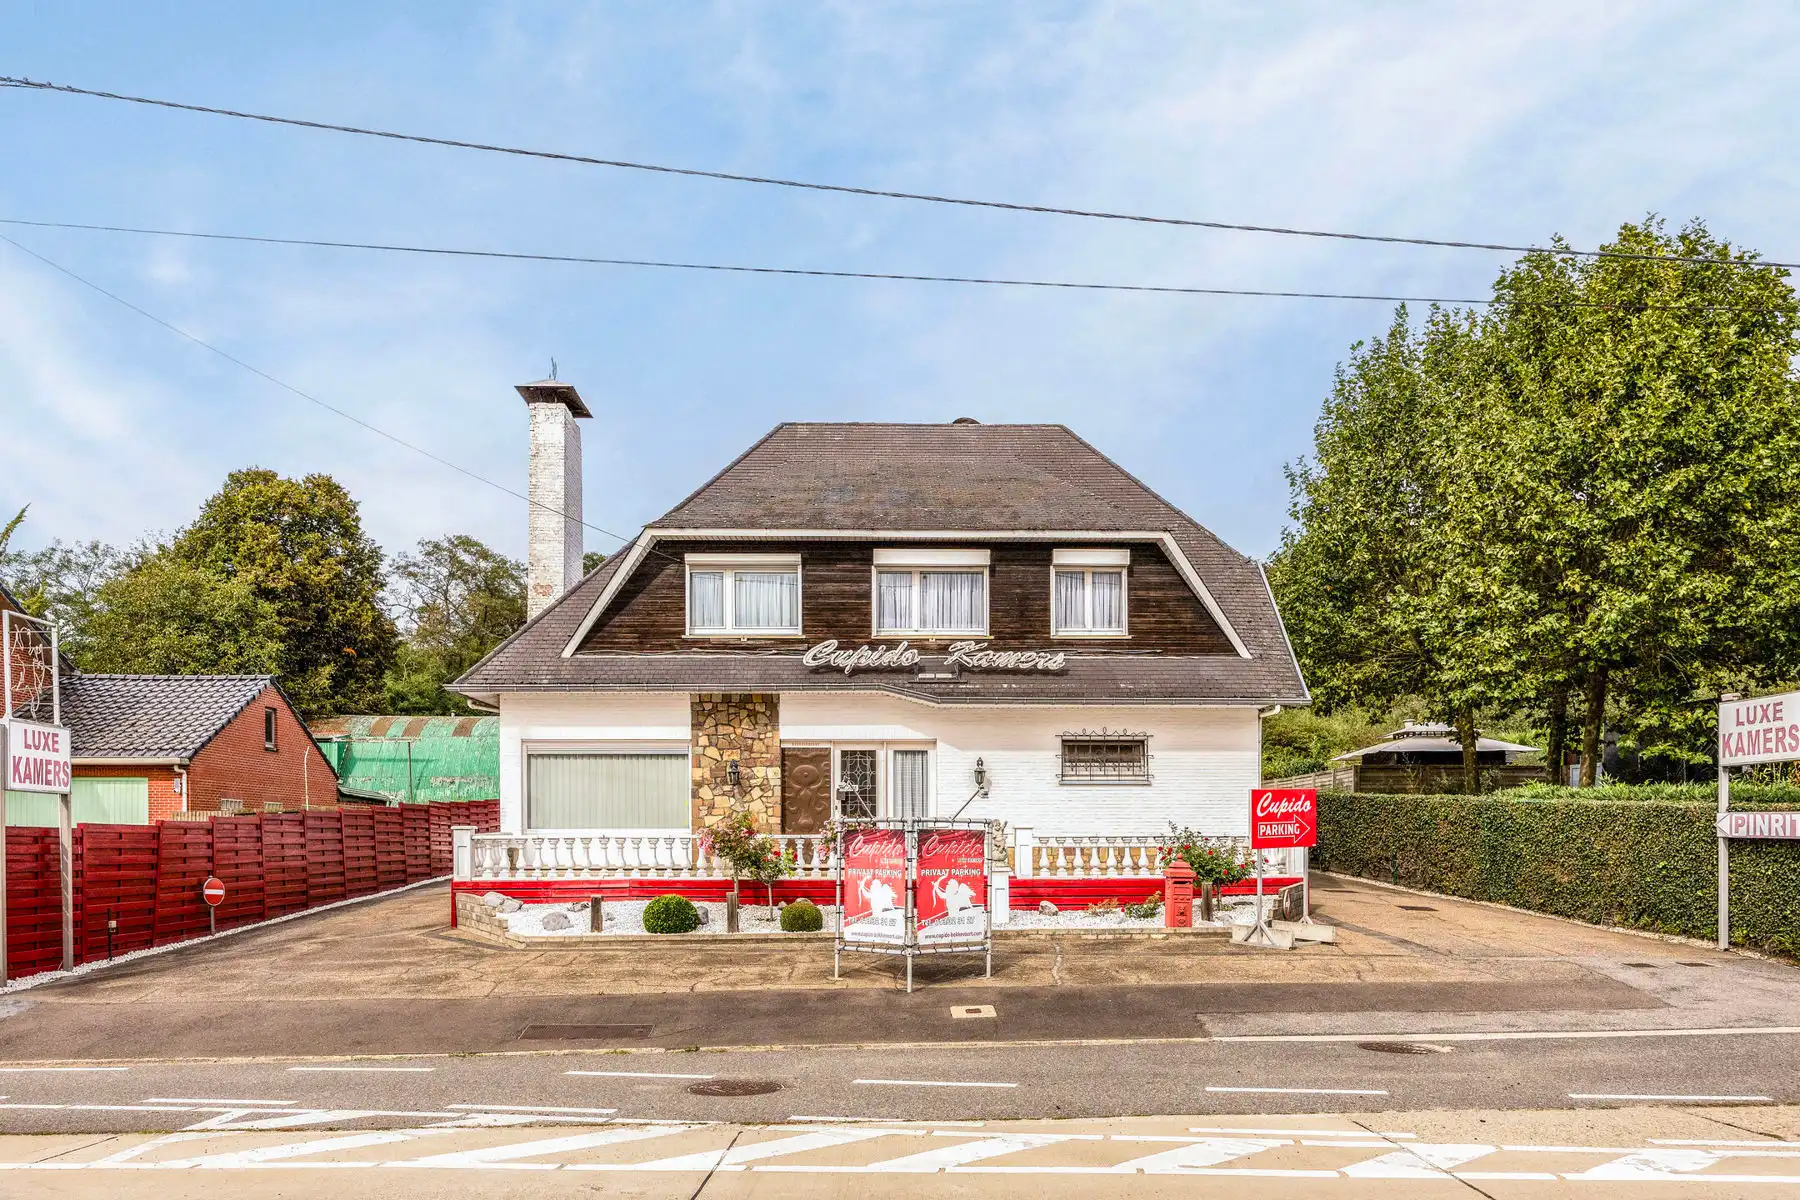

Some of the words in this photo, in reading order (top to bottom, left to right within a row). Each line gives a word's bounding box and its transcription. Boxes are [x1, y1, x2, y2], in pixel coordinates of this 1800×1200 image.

[803, 639, 920, 675] Cupido
[944, 640, 1066, 671] Kamers
[1736, 701, 1784, 727] LUXE
[24, 728, 60, 753] LUXE
[1721, 724, 1800, 758] KAMERS
[12, 755, 70, 788] KAMERS
[1257, 792, 1312, 818] Cupido
[1259, 824, 1300, 836] PARKING
[849, 835, 903, 862] Cupido
[922, 835, 982, 862] Cupido
[848, 868, 874, 877] PRIVAAT
[875, 868, 902, 877] PARKING
[921, 868, 950, 877] PRIVAAT
[951, 868, 981, 877] PARKING
